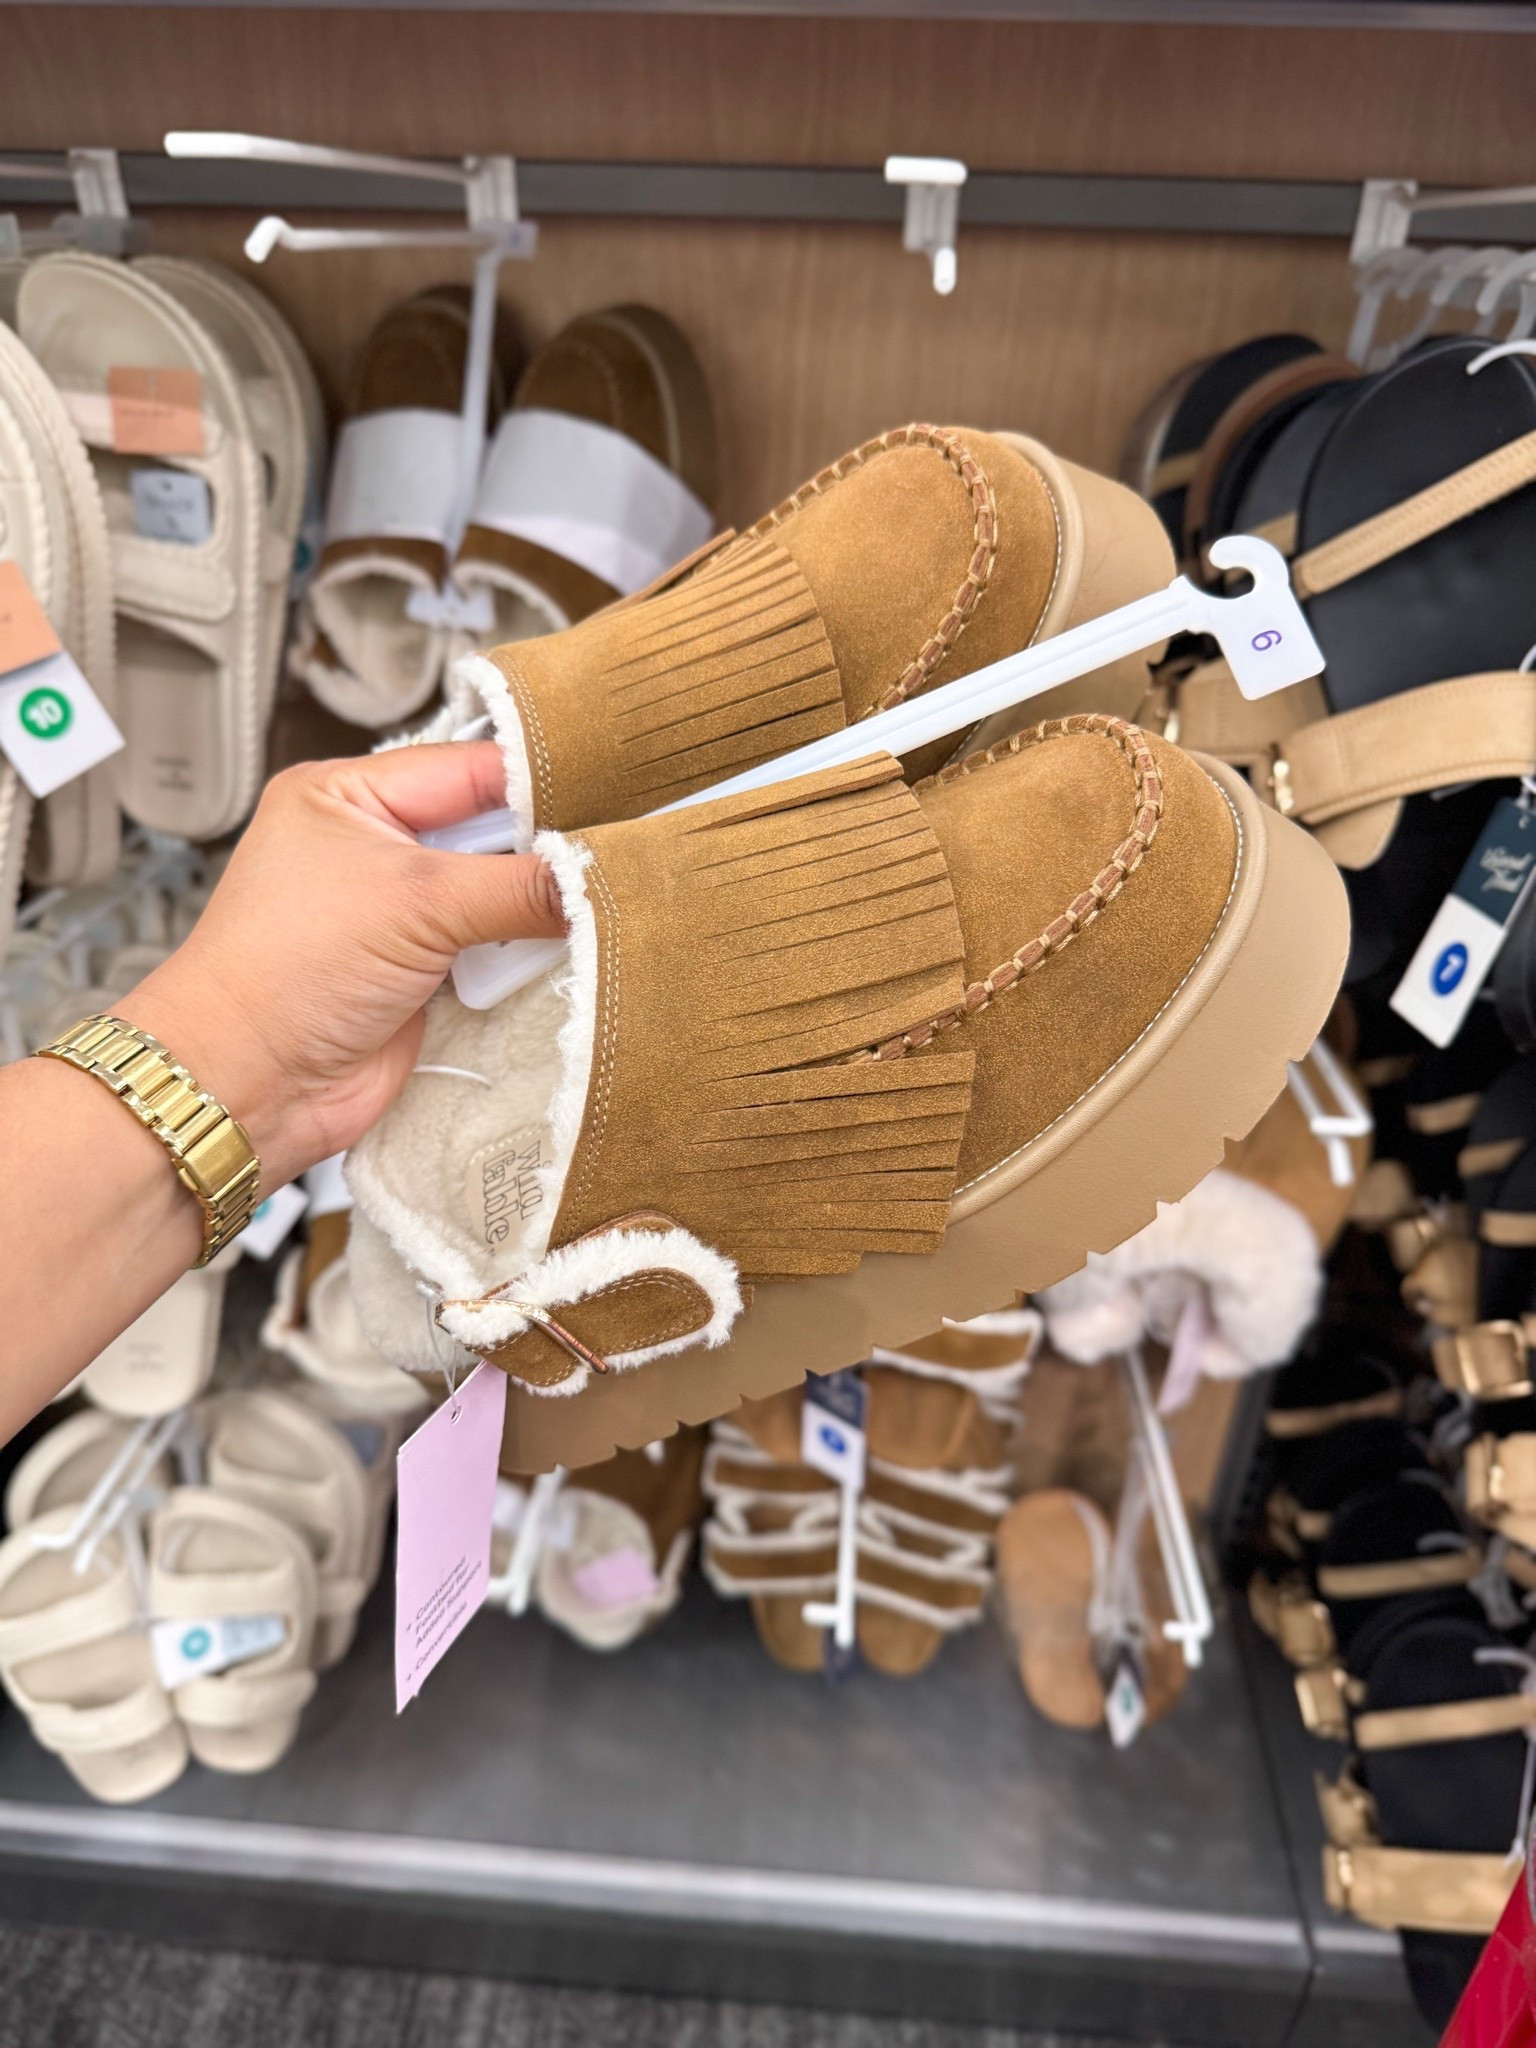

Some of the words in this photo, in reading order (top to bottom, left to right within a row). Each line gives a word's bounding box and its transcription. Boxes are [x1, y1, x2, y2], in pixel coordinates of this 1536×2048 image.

[26, 697, 64, 731] 10
[1440, 953, 1465, 983] 7
[416, 1556, 466, 1620] Contoured
[416, 1606, 445, 1648] Added
[416, 1601, 468, 1670] Convertible
